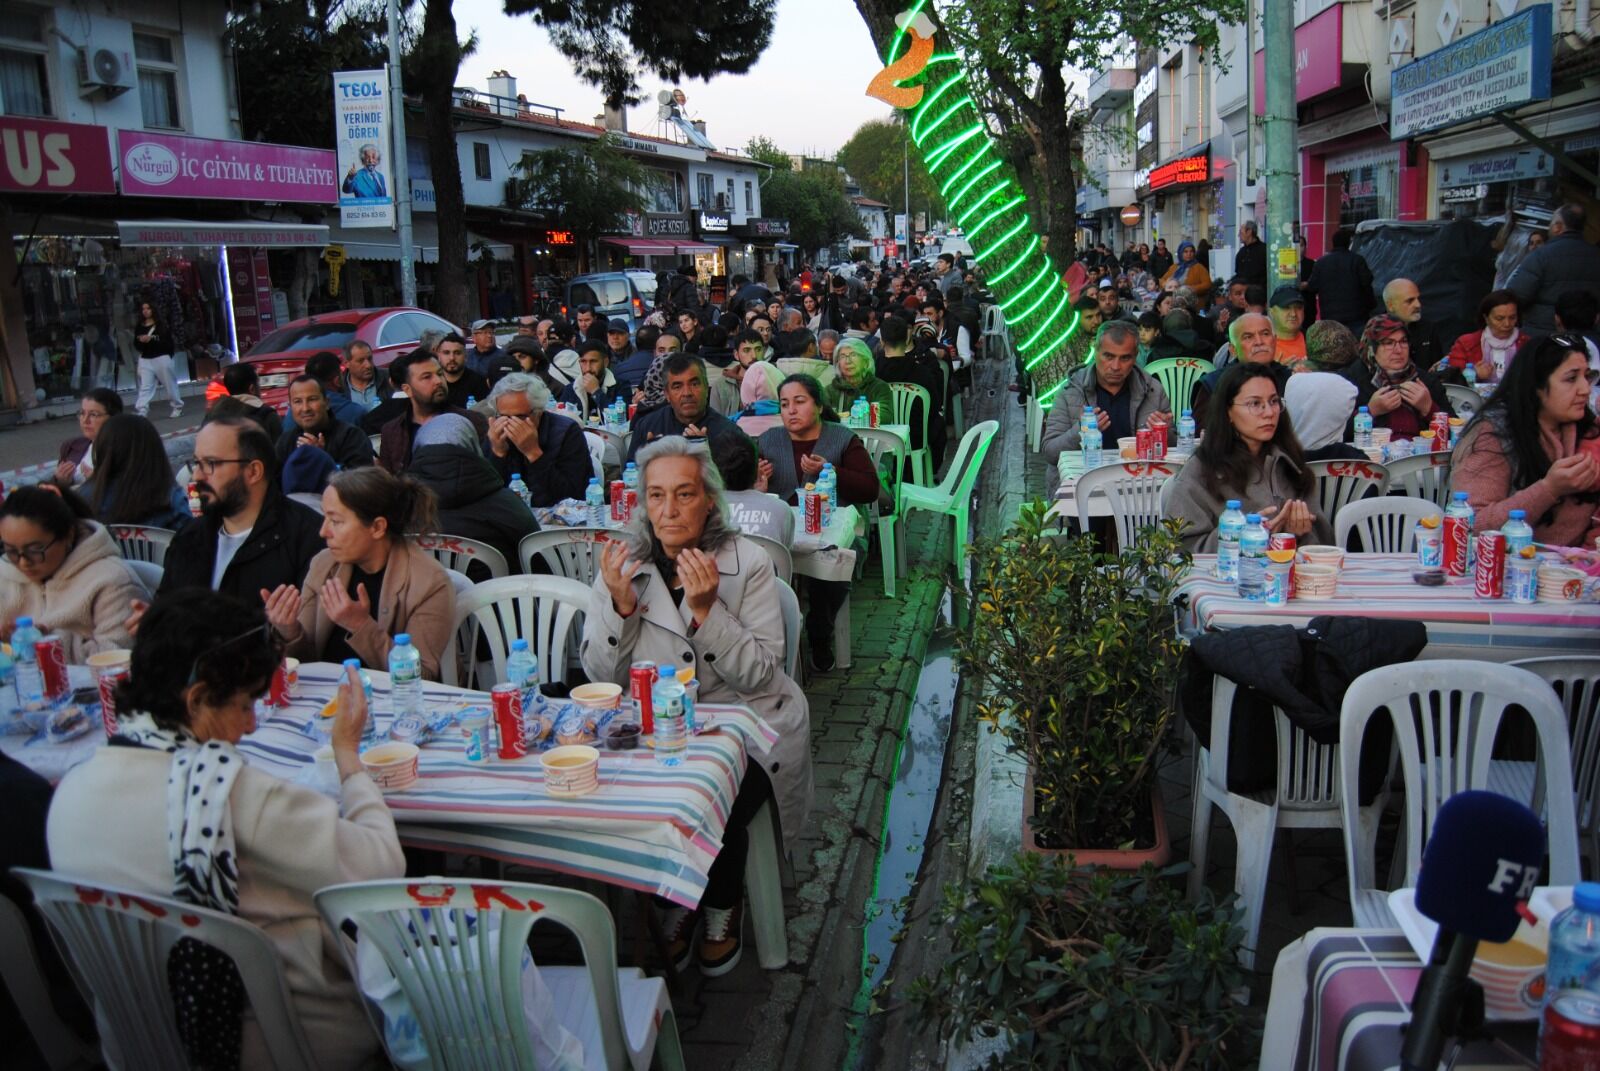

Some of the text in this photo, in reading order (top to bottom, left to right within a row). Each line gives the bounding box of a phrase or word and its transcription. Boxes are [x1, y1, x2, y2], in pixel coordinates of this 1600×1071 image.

[338, 80, 382, 98] TEOL
[343, 110, 382, 125] YERİNDE
[348, 125, 379, 139] ÖĞREN
[0, 128, 76, 187] US
[180, 151, 334, 186] İÇ GİYİM & TUHAFİYE
